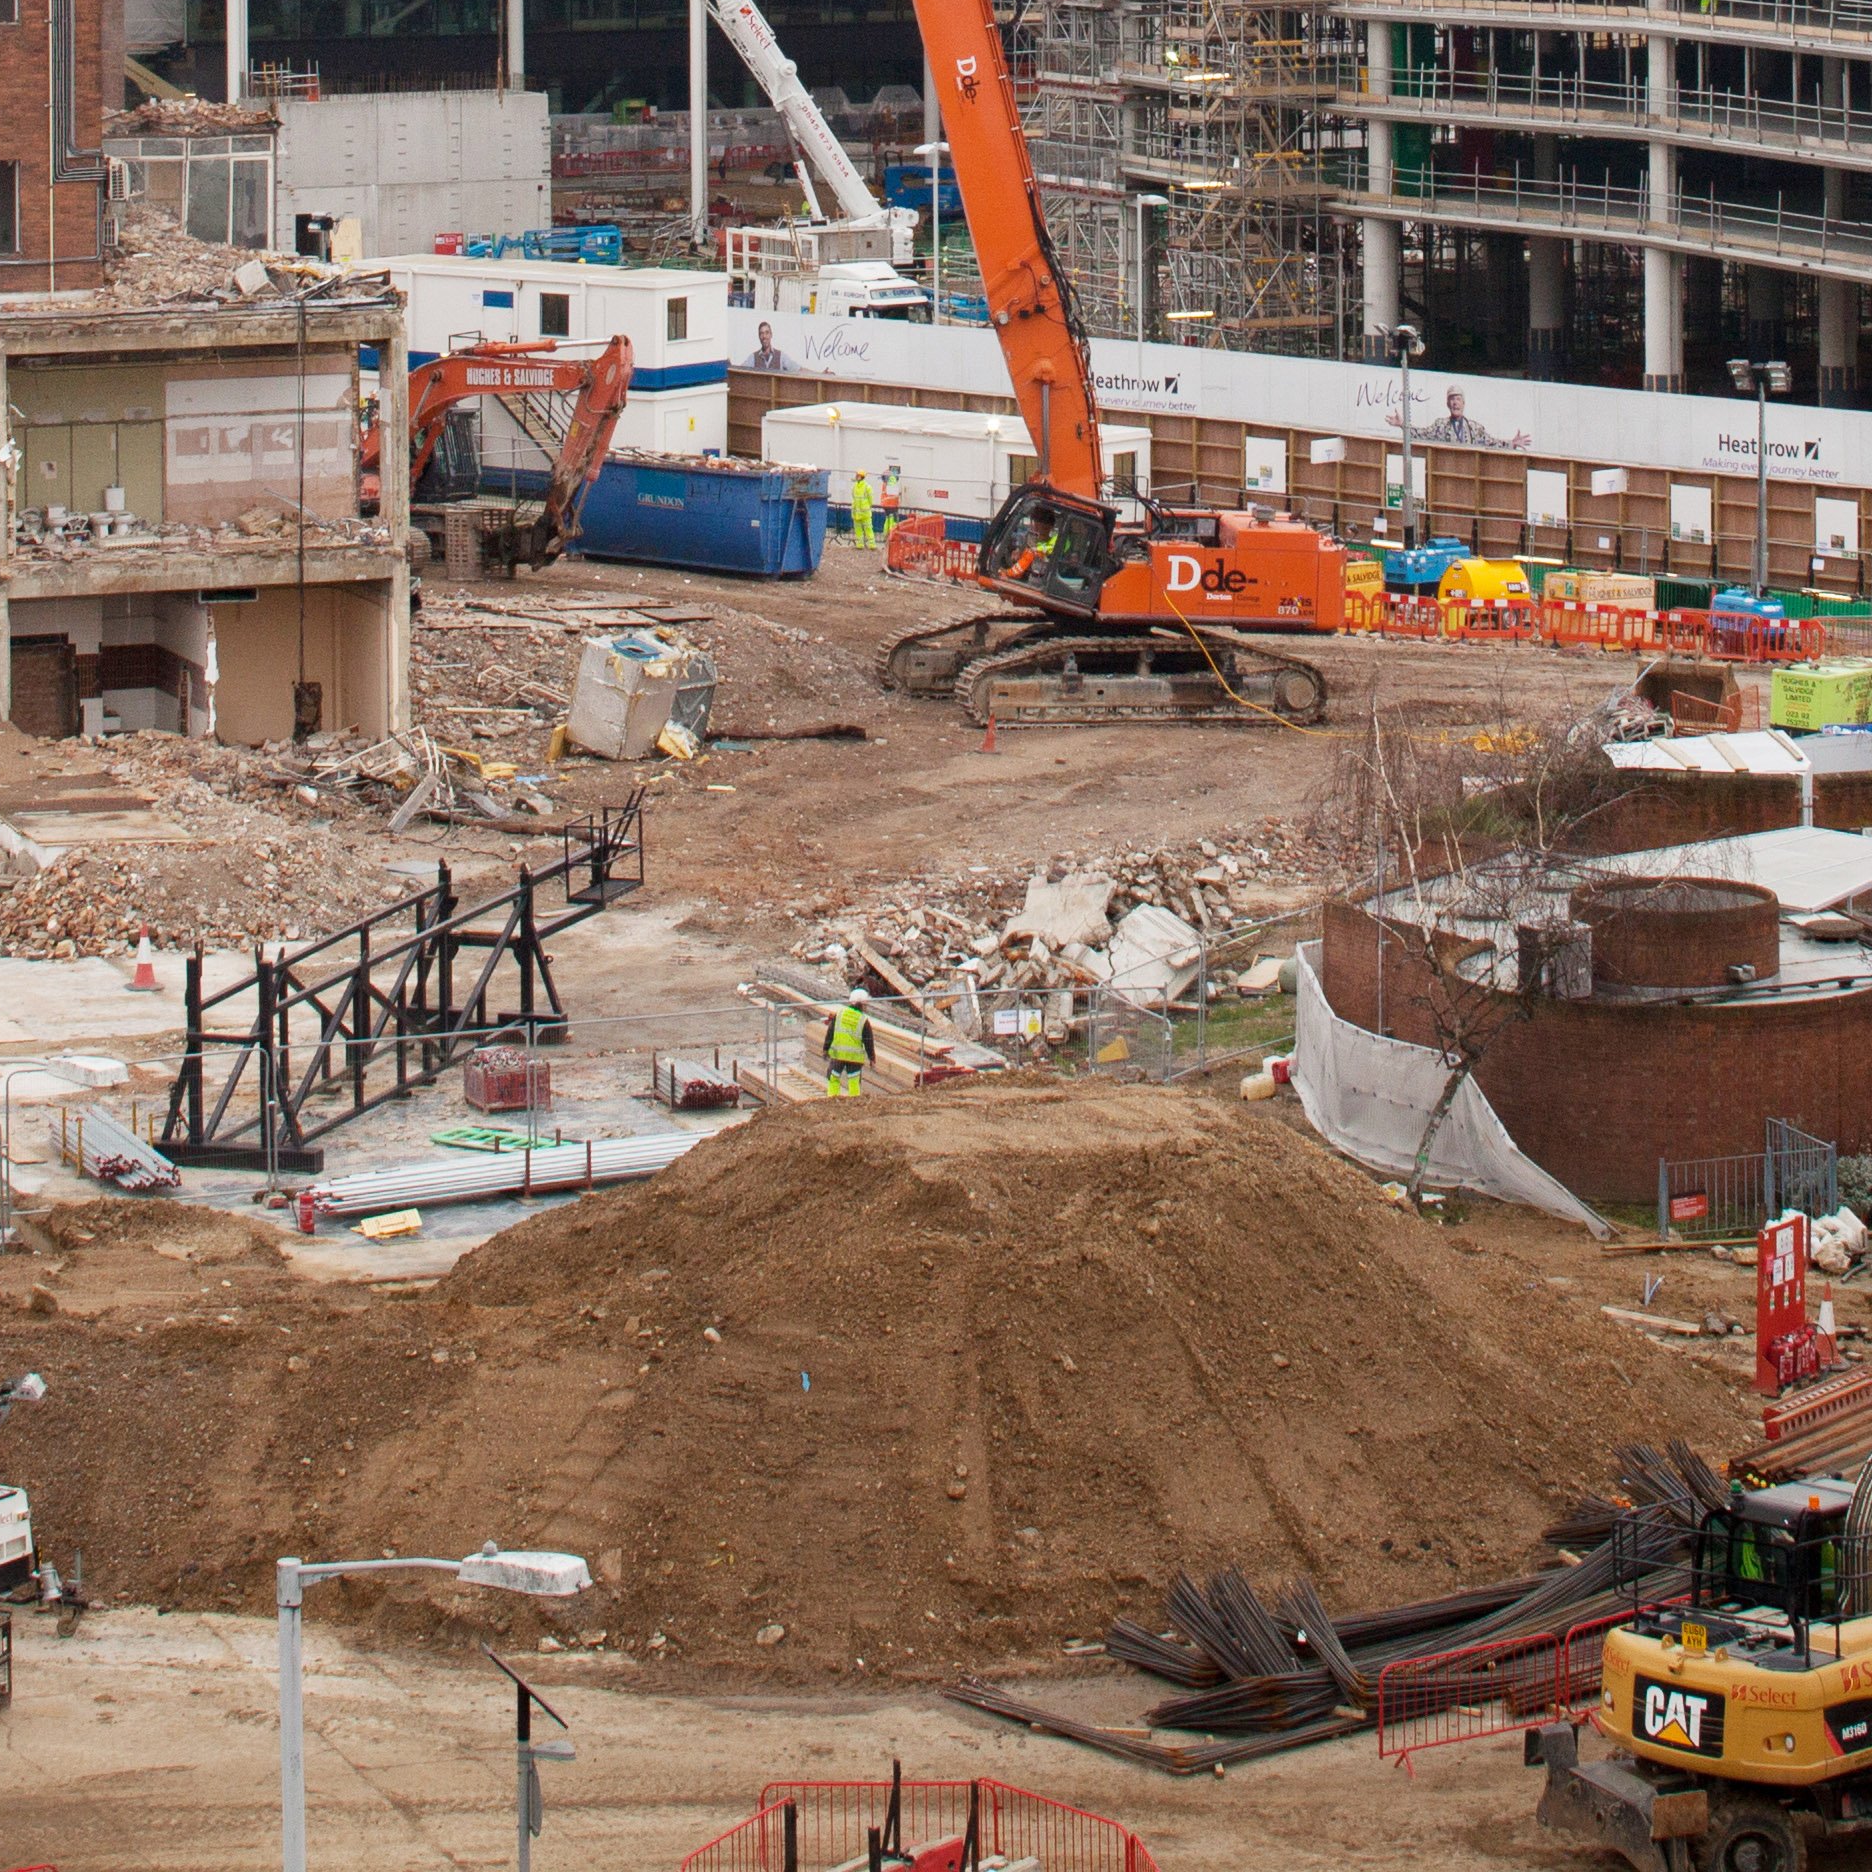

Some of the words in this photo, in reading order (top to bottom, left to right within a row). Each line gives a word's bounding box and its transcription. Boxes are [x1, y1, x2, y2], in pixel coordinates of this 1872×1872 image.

[746, 14, 771, 50] Select
[804, 323, 871, 362] Welcome
[466, 367, 501, 385] HUGHES
[503, 368, 511, 385] &
[513, 368, 554, 386] SALVIDGE
[1168, 402, 1197, 412] better
[1702, 457, 1740, 472] Making
[1768, 464, 1807, 478] journey
[1808, 466, 1840, 478] better
[637, 492, 685, 507] GRUNDON
[1167, 555, 1259, 593] Dde-
[1277, 606, 1299, 616] 870
[1781, 677, 1809, 687] HUGHES
[1783, 686, 1814, 695] SALVIDGE
[1785, 693, 1812, 703] LIMITED
[1749, 1685, 1797, 1705] Select
[1644, 1685, 1708, 1748] CAT
[1841, 1721, 1868, 1740] M316D
